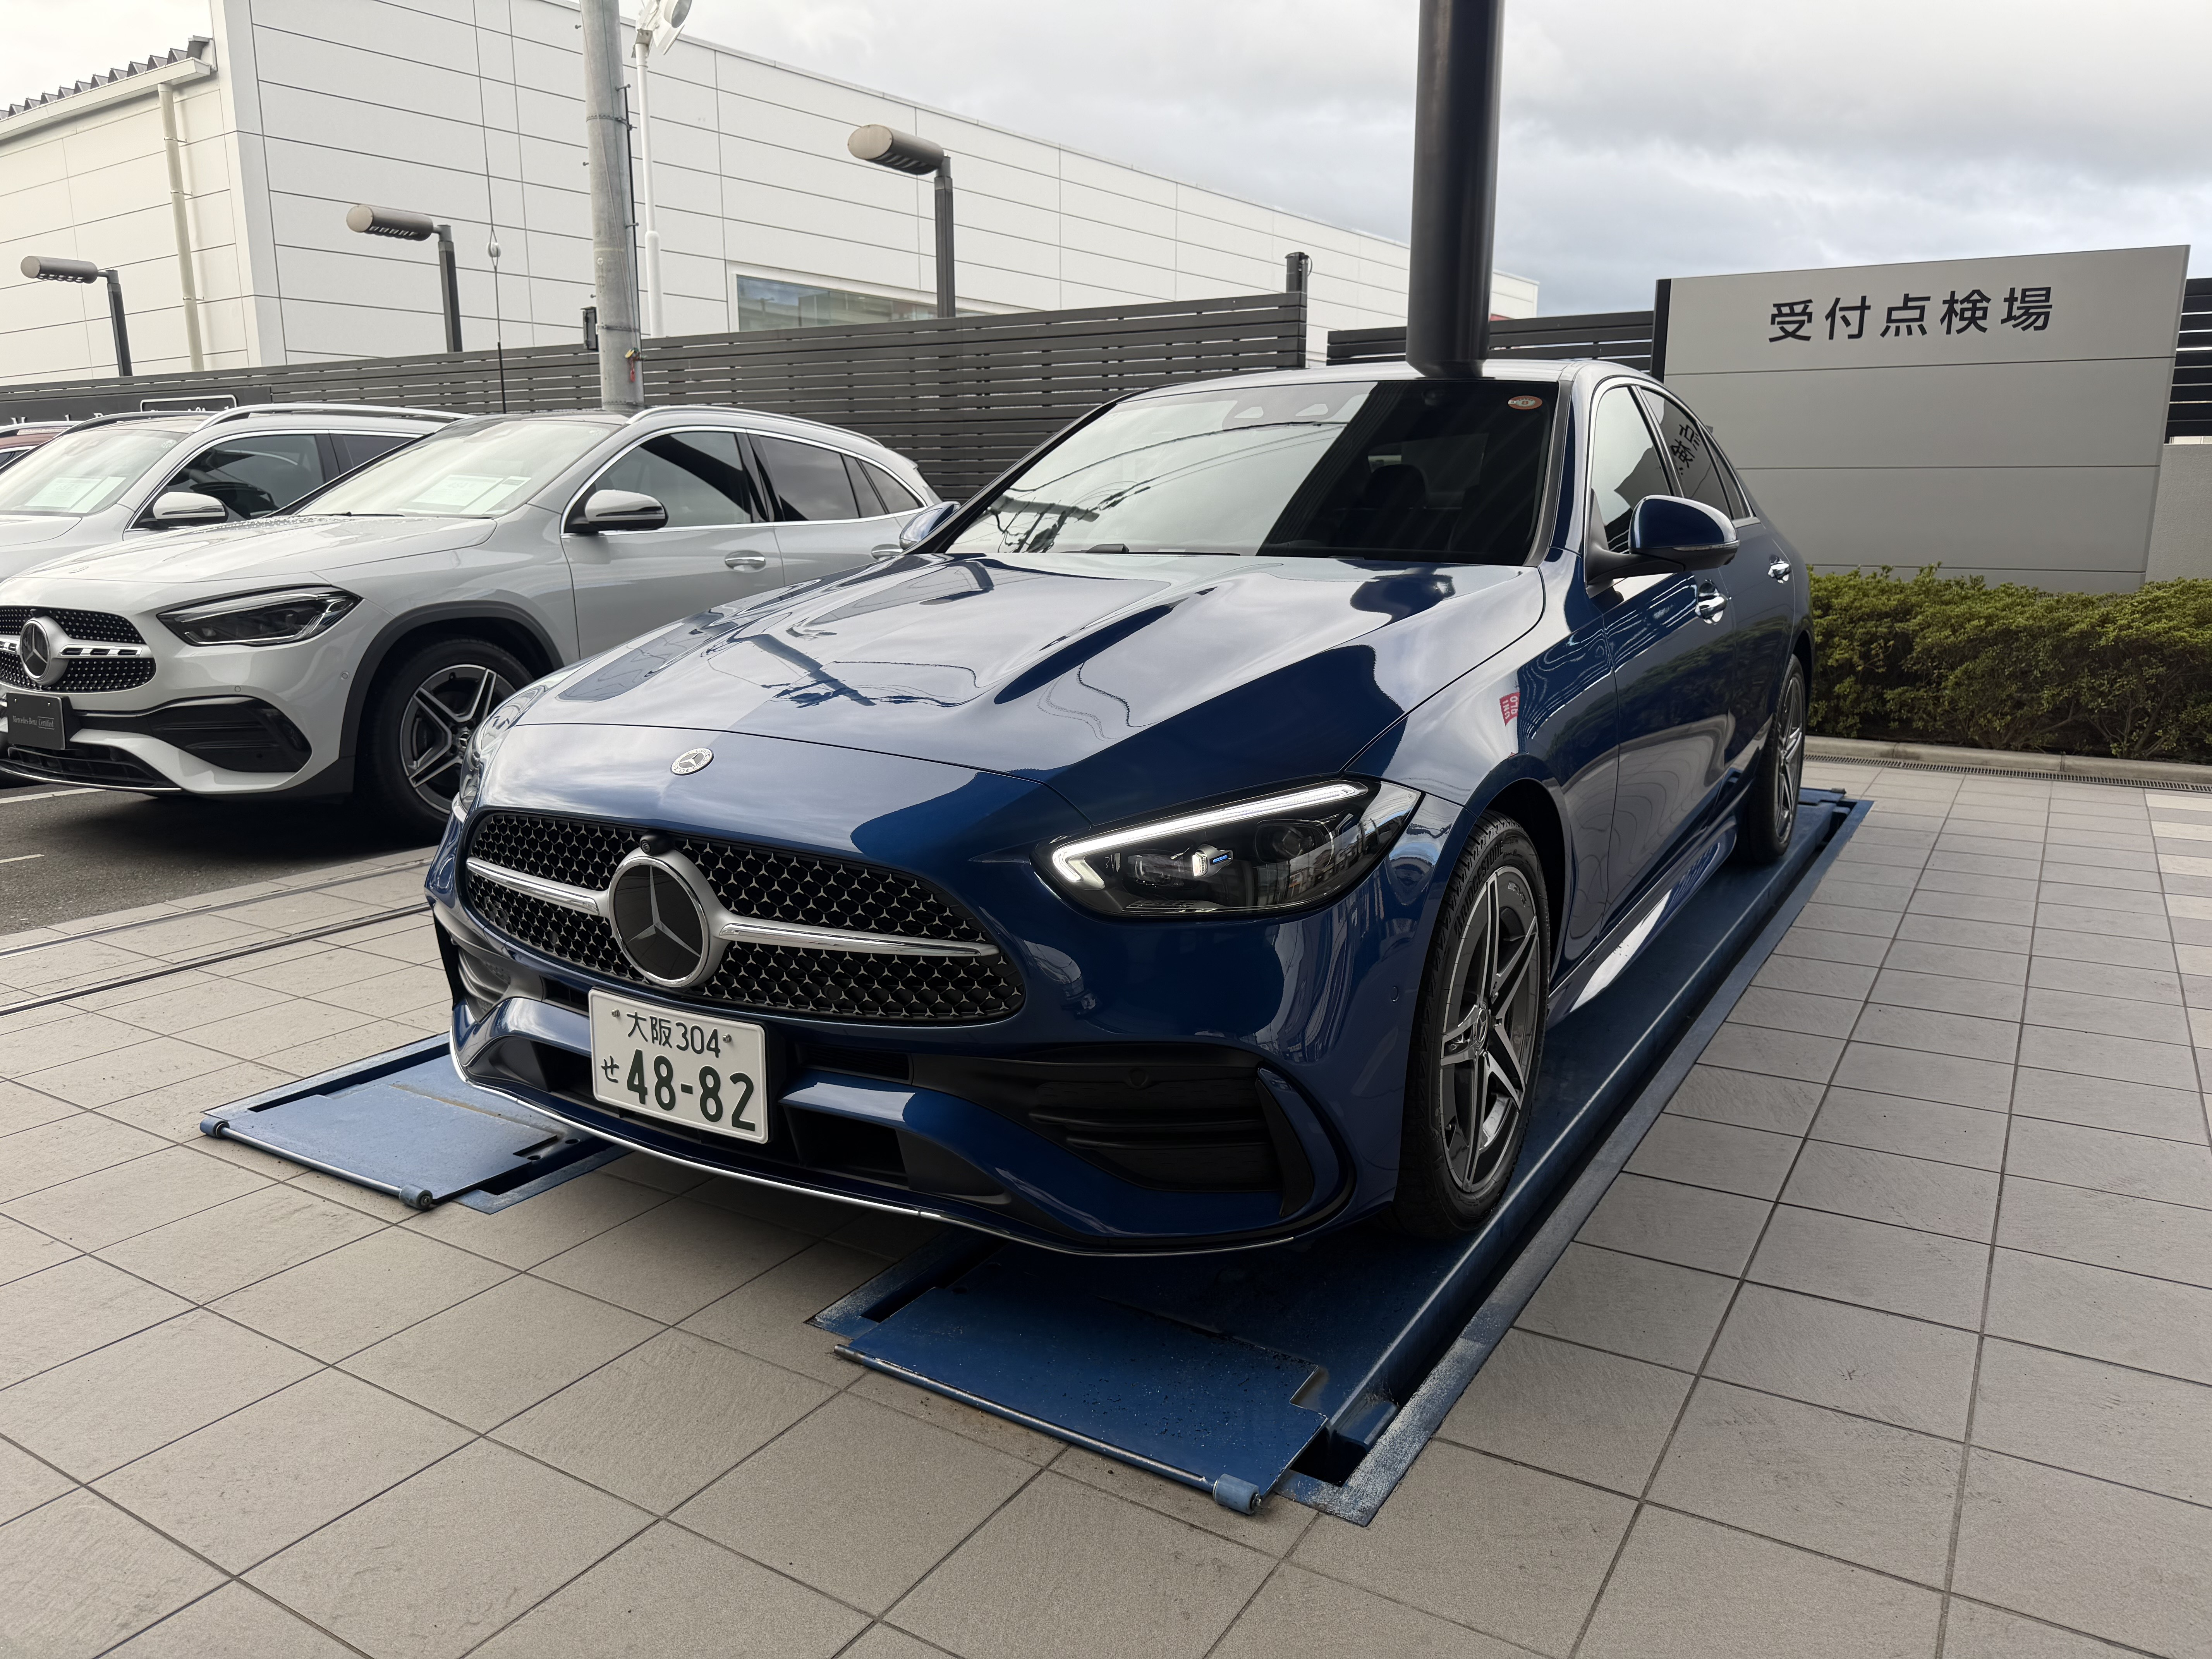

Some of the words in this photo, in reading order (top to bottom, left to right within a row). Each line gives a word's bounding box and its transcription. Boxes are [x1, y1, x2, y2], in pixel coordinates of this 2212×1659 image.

[1768, 286, 2053, 343] 受付点検場
[601, 1055, 620, 1083] せ
[627, 1048, 756, 1132] 48-82
